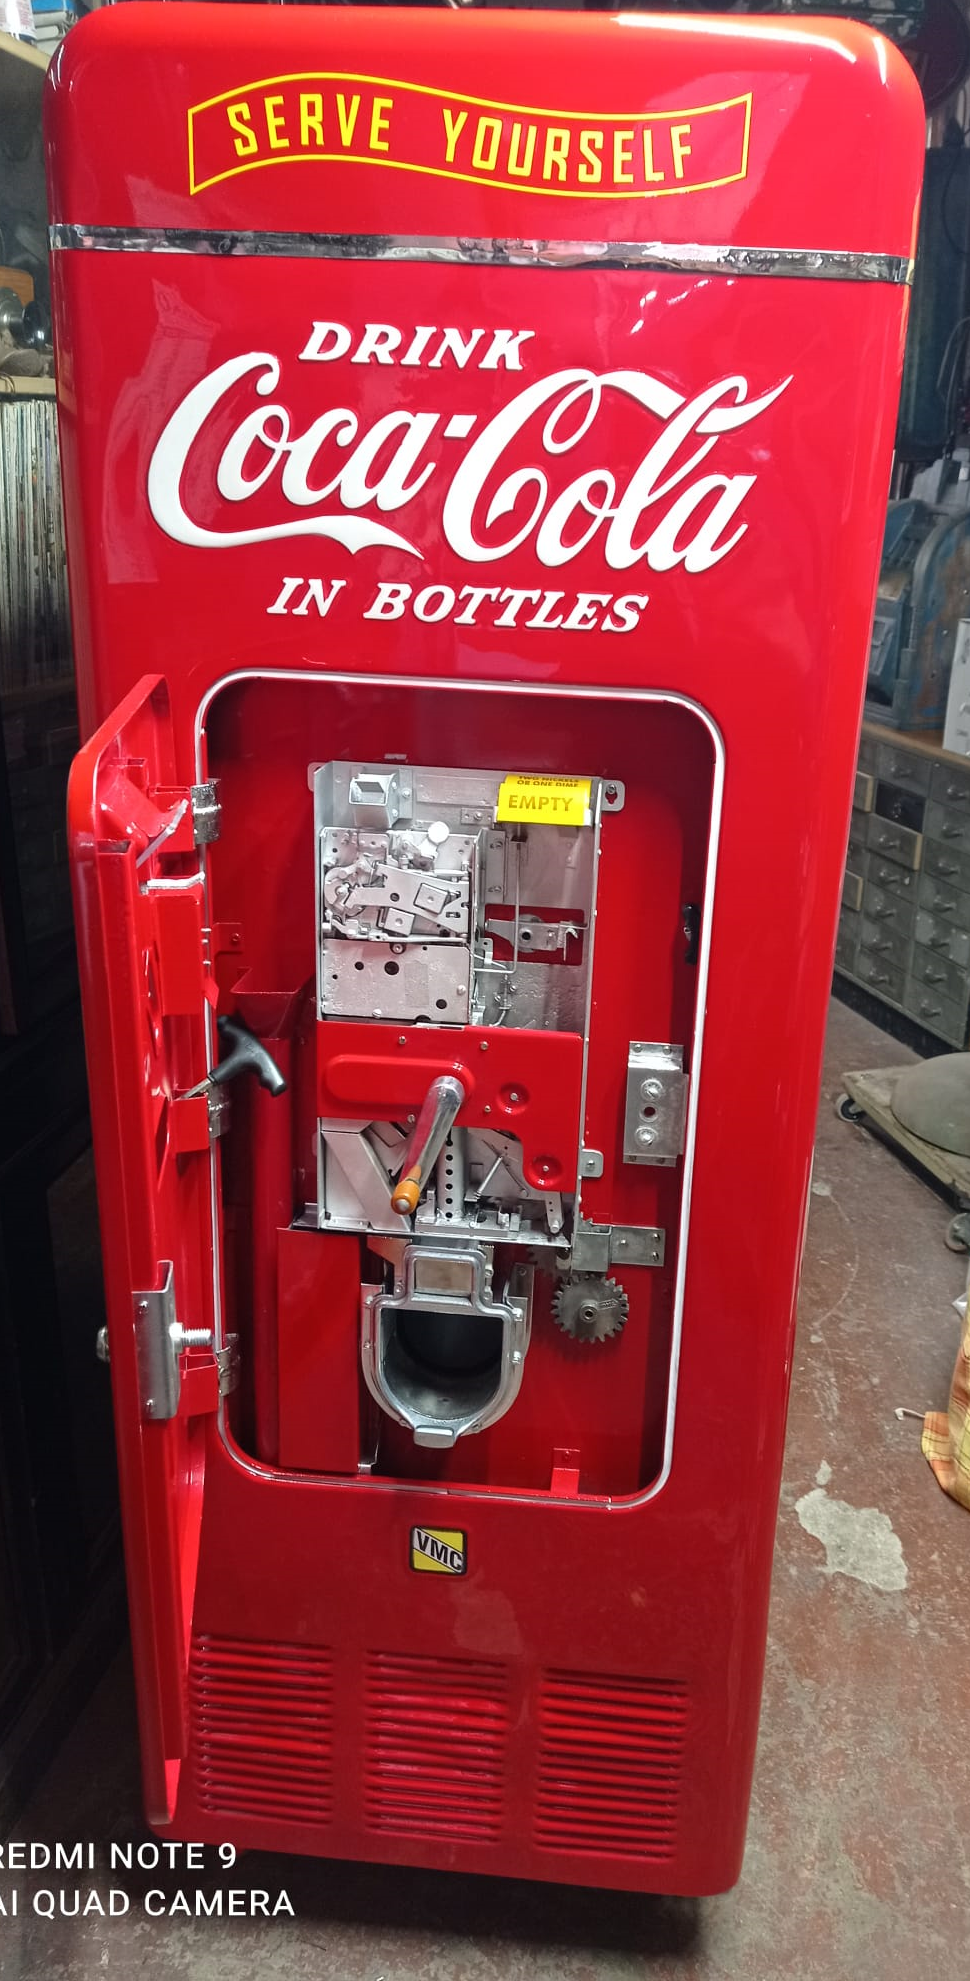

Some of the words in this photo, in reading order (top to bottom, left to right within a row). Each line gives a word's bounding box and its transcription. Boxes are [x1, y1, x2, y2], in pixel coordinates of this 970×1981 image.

[227, 94, 394, 157] SERVE
[443, 108, 692, 184] YOURSELF
[298, 320, 535, 371] DRINK
[147, 351, 794, 573] Coca-Cola
[266, 577, 348, 617] IN
[363, 581, 649, 633] BOTTLES
[508, 794, 574, 812] EMPTY
[416, 1530, 463, 1571] VMC
